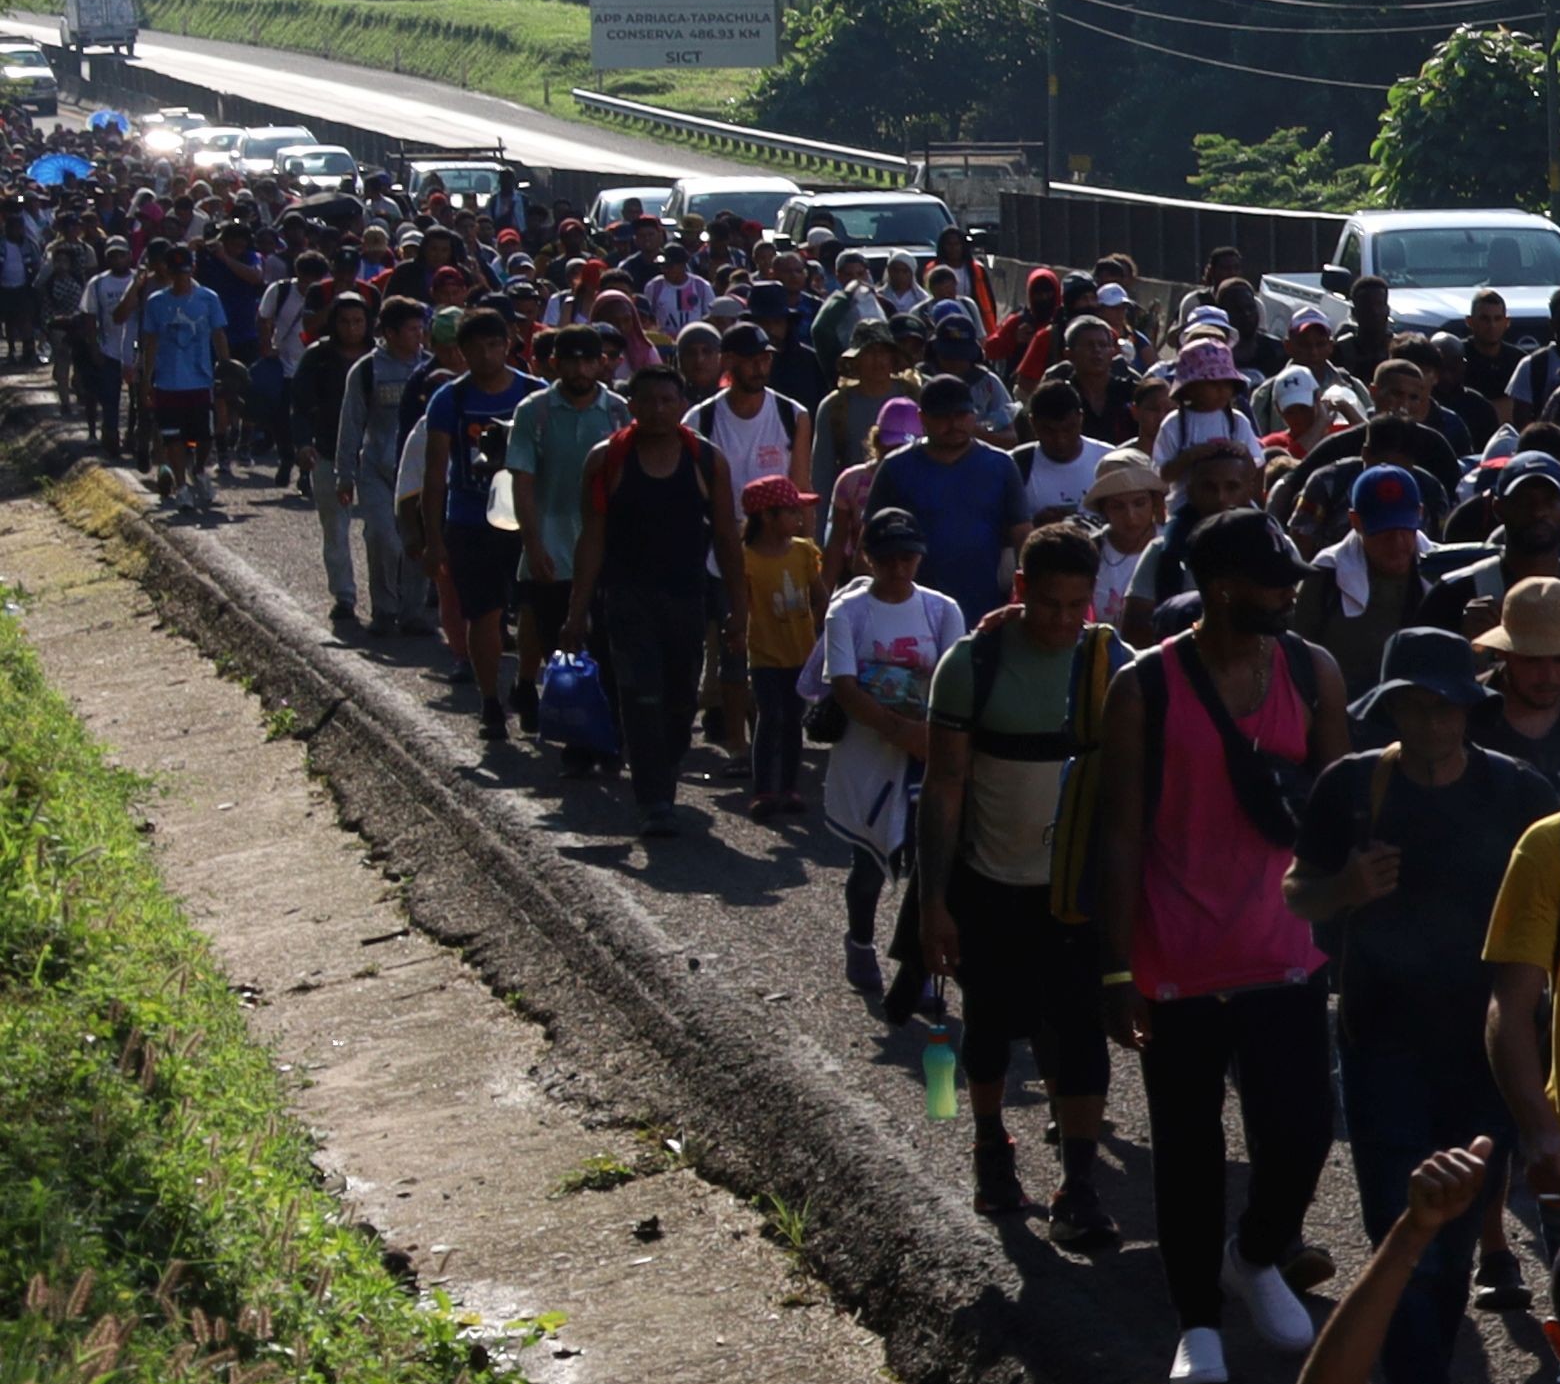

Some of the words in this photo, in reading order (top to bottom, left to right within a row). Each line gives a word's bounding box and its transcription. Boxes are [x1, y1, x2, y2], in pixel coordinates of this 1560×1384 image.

[594, 14, 622, 24] APP
[626, 13, 772, 24] ARRIAGA-TAPACHULA
[606, 29, 684, 41] CONSERVA
[689, 29, 735, 40] 486.93
[739, 29, 761, 39] KM
[665, 51, 703, 64] SICT
